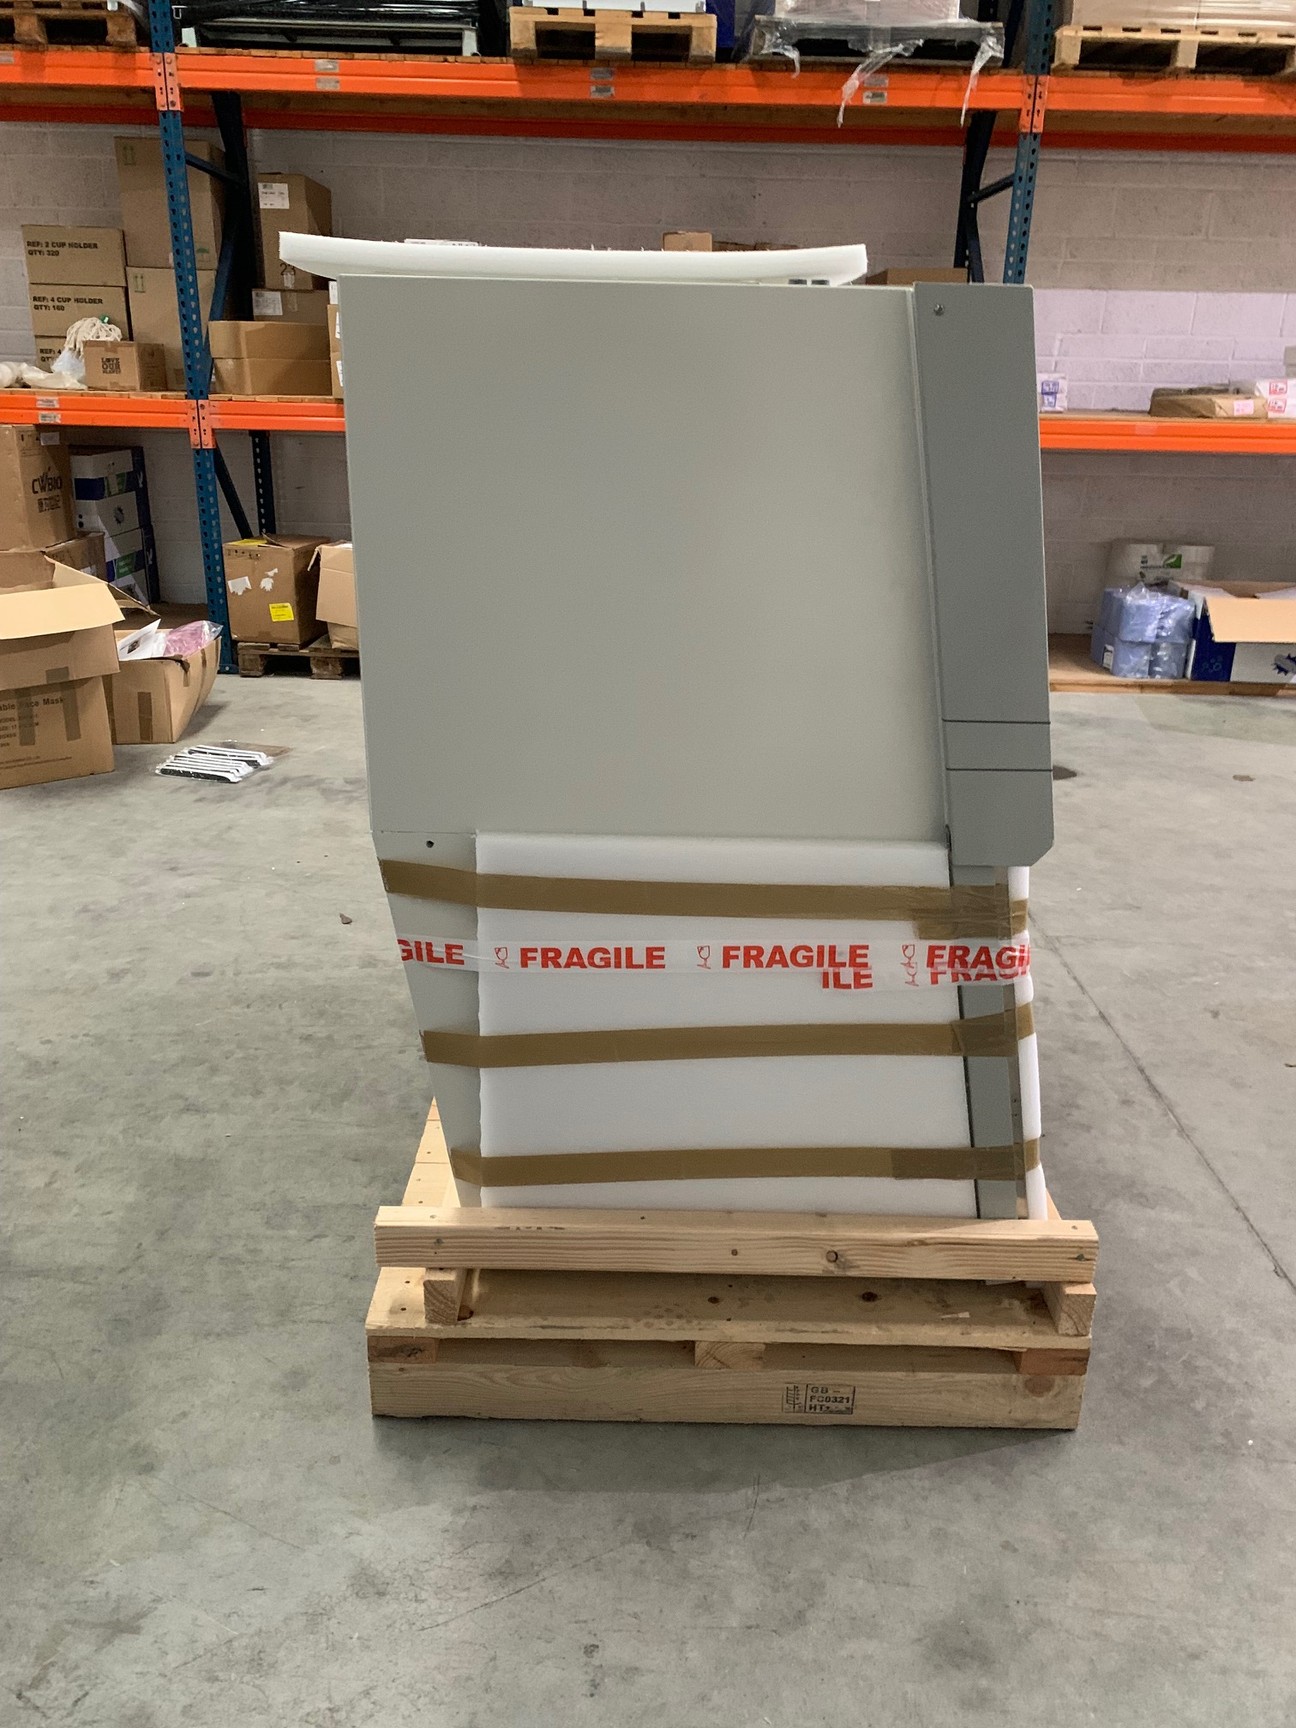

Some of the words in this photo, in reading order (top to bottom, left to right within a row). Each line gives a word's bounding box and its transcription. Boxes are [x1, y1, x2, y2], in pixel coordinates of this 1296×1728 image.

[520, 946, 666, 970] FRAGILE
[722, 944, 870, 969] FRAGILE
[811, 1386, 829, 1395] GB
